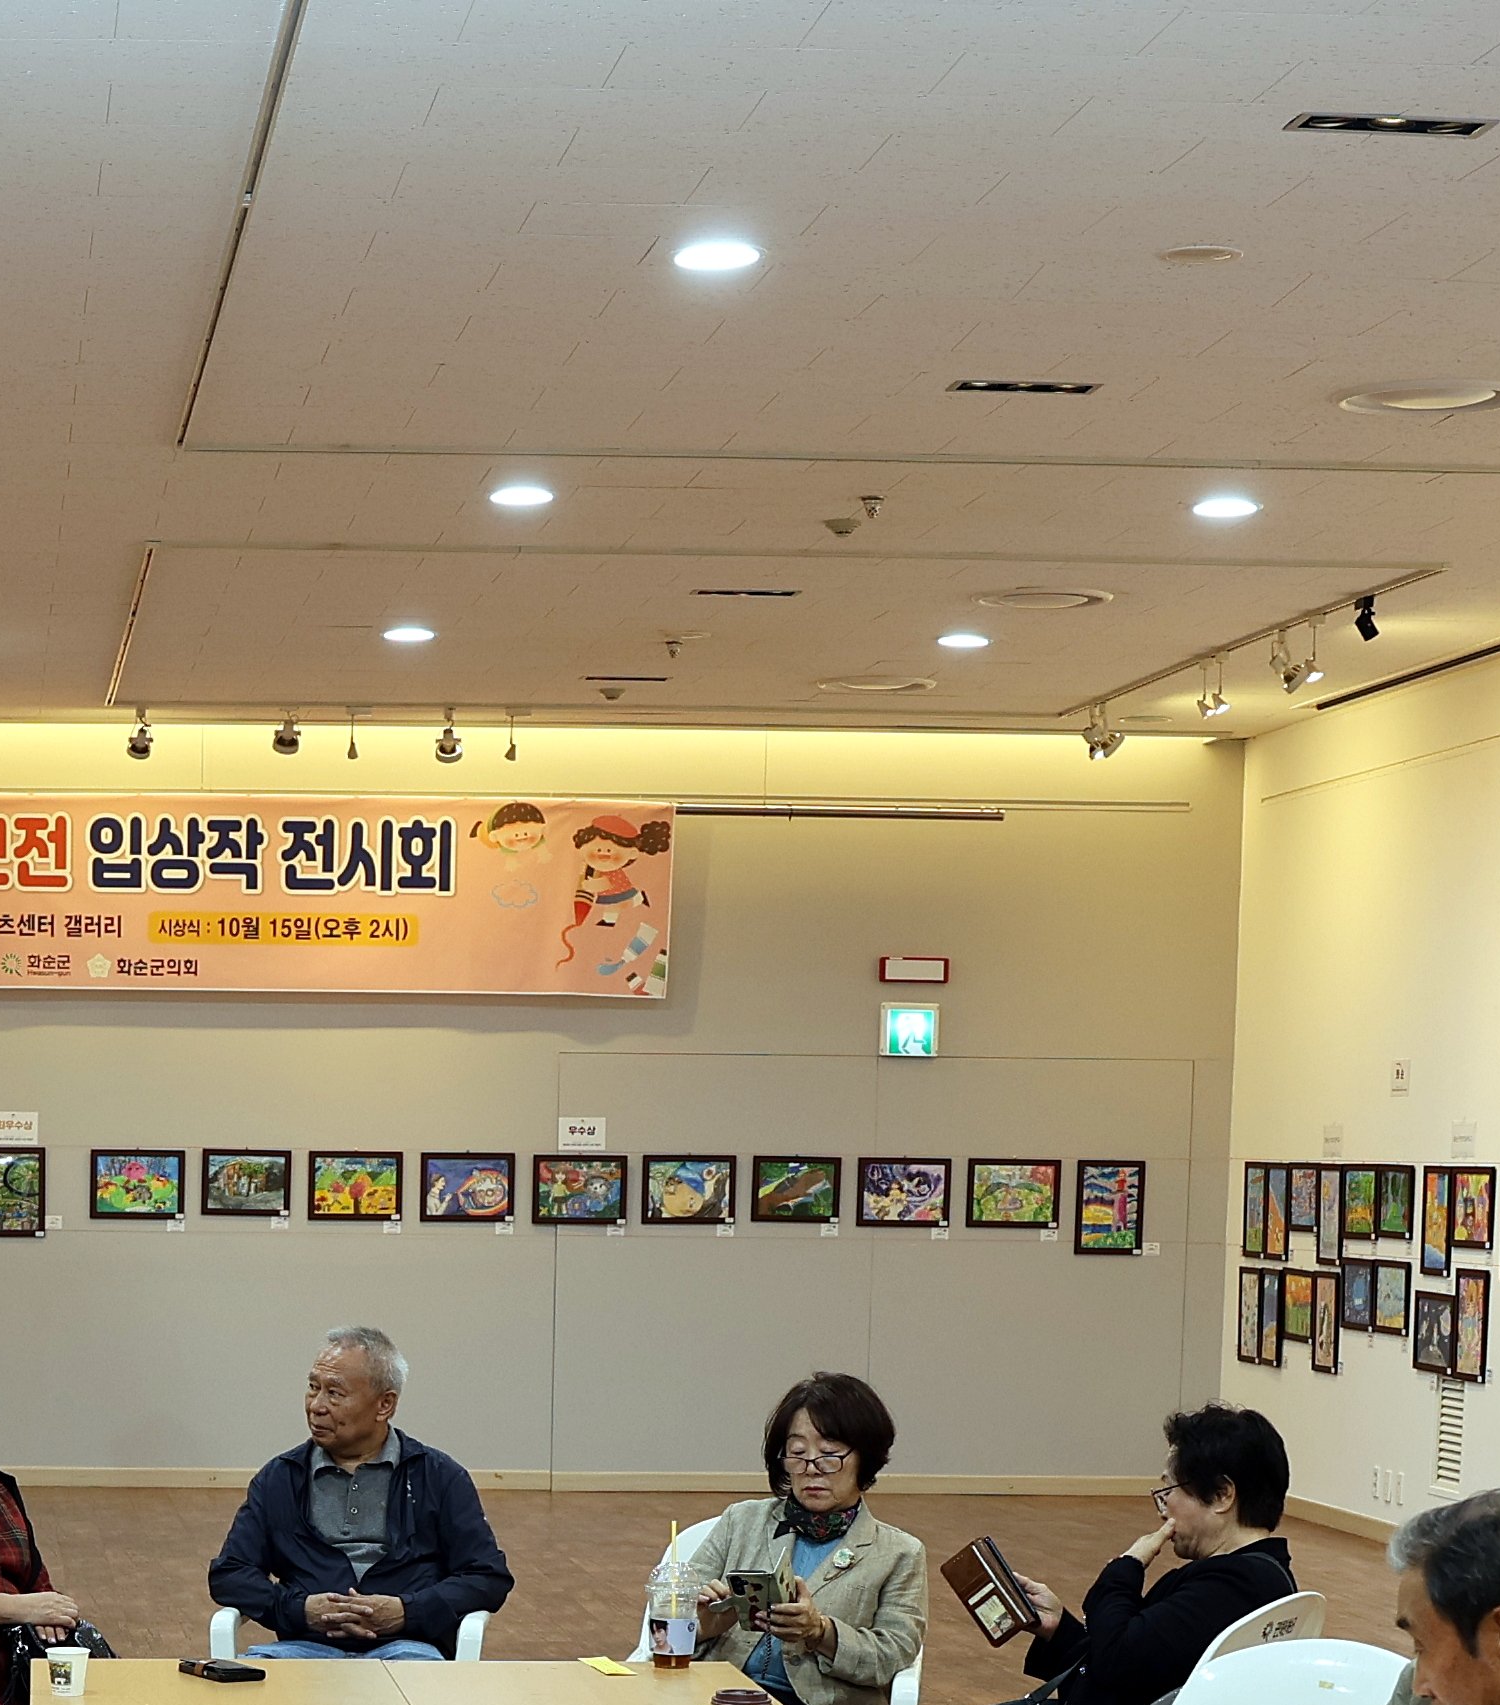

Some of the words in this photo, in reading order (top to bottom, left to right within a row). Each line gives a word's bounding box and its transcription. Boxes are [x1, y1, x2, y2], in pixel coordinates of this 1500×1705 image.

[89, 815, 266, 891] 입상작
[281, 817, 452, 893] 전시회
[63, 914, 123, 939] 갤러리
[158, 918, 201, 938] 시상식
[217, 916, 260, 939] 10월
[268, 916, 363, 941] 15일(오후
[368, 916, 409, 941] 2시)
[26, 953, 71, 970] 화순군
[116, 958, 199, 977] 화순군의회
[568, 1125, 597, 1136] 우수상
